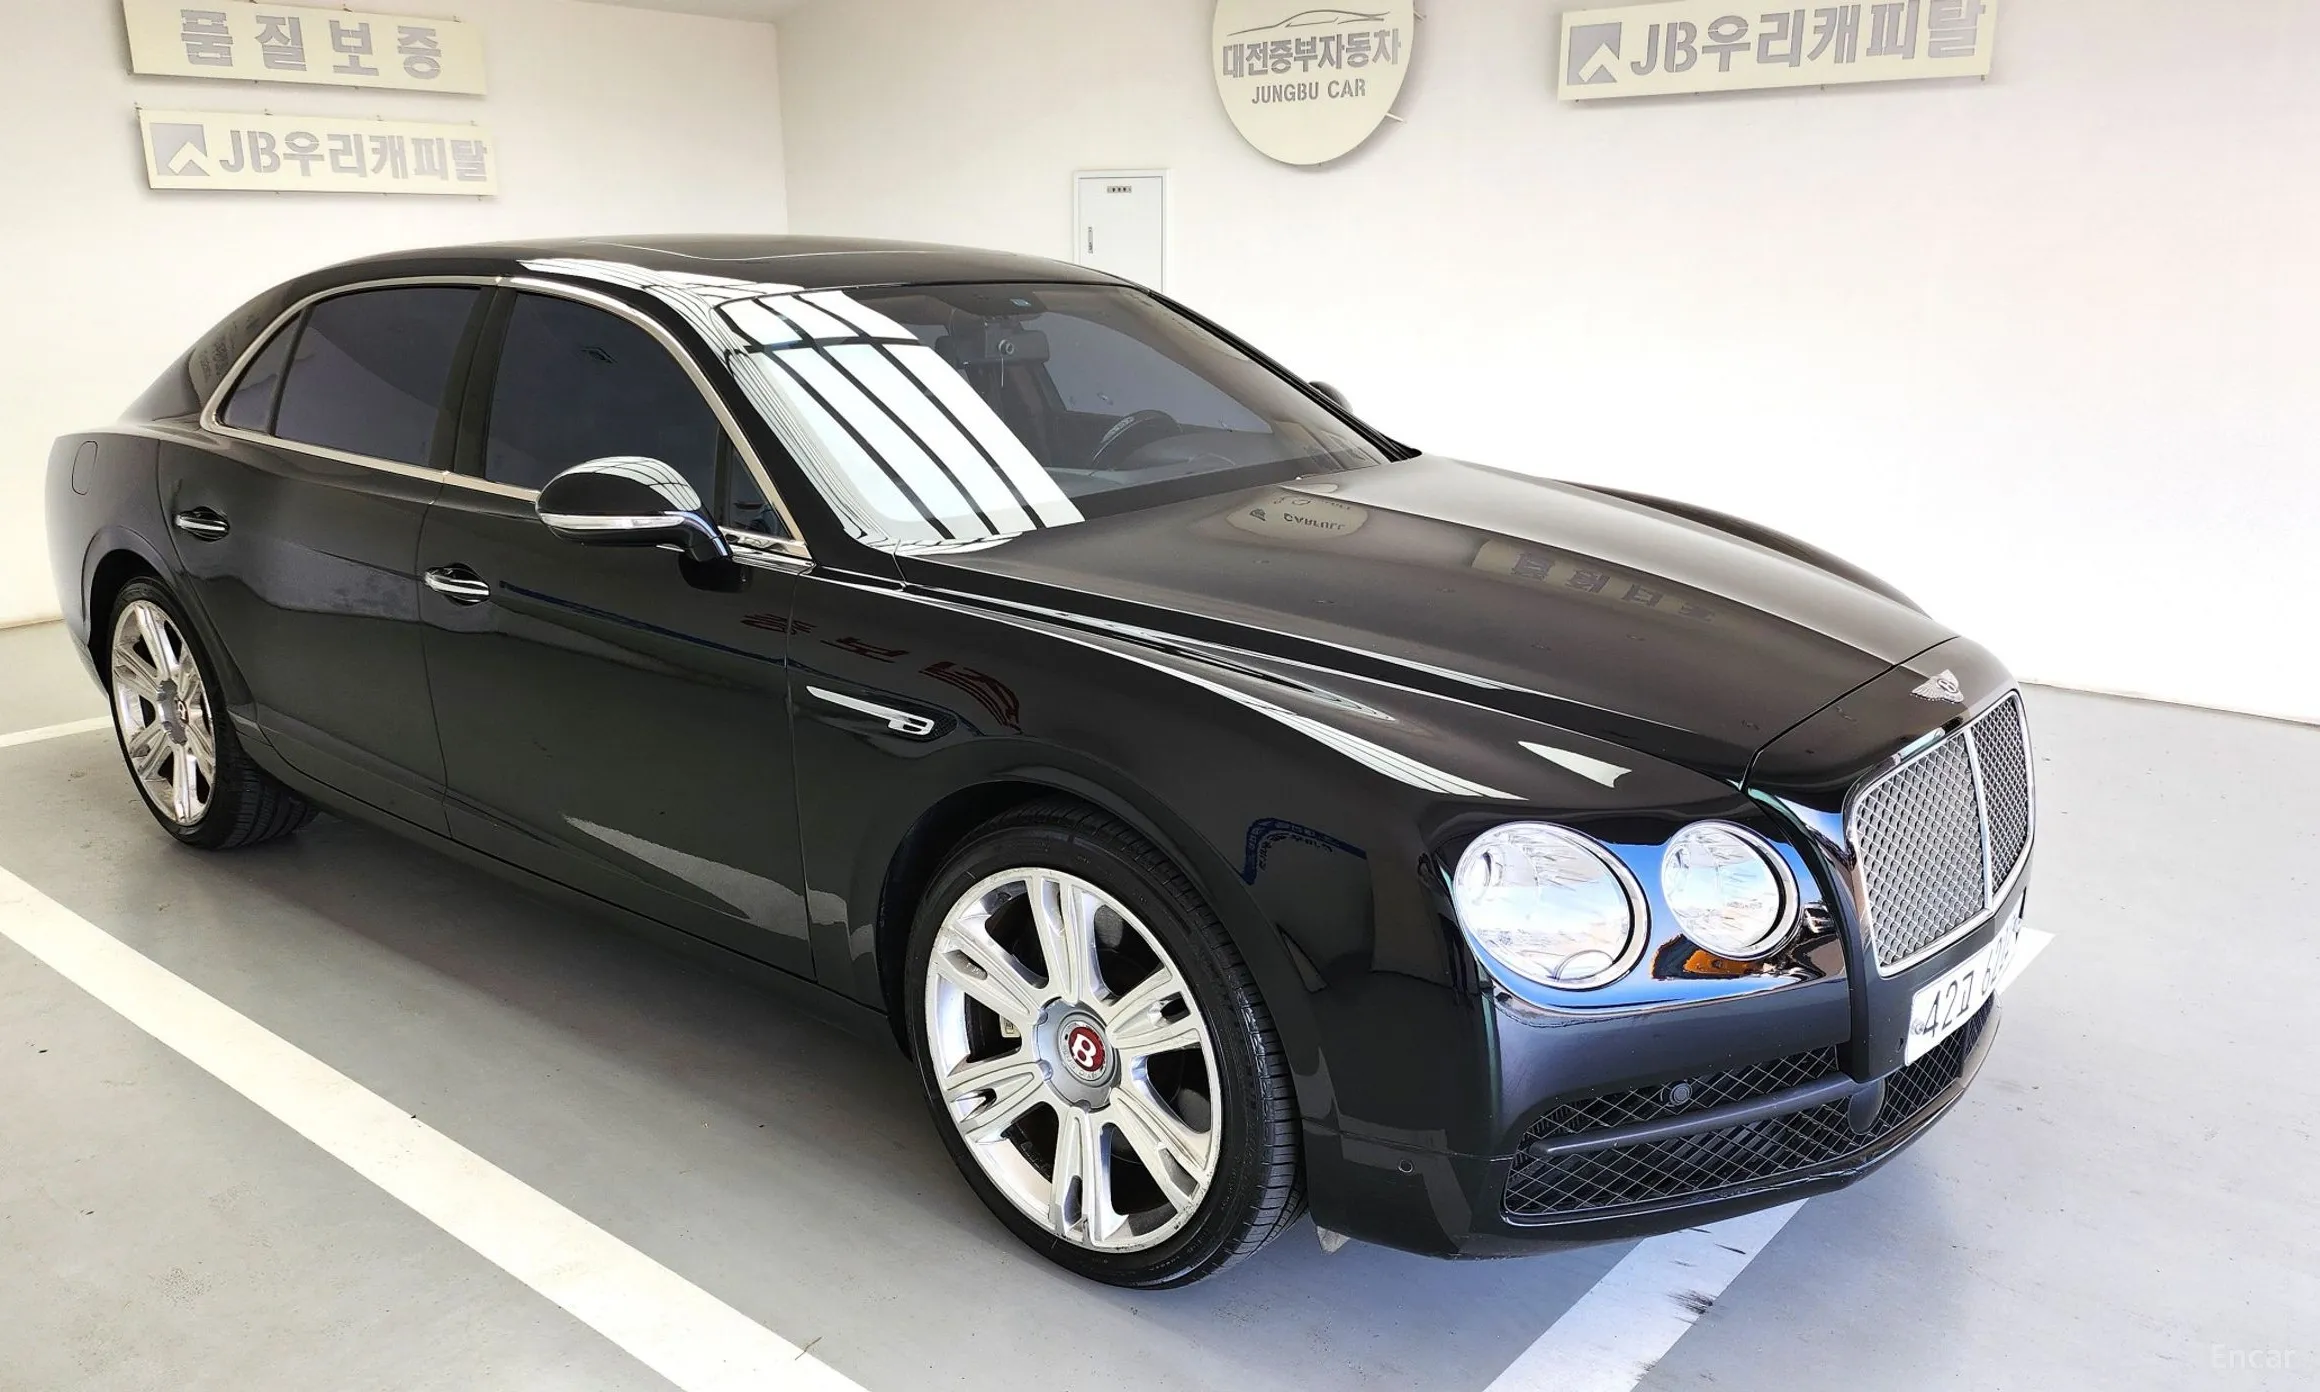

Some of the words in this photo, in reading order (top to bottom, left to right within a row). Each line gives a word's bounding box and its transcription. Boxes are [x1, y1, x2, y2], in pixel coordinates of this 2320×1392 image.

[180, 9, 442, 80] 품질보증
[1222, 28, 1402, 79] 대전중부자동차
[1631, 0, 1987, 76] JB우리캐피탈
[1252, 81, 1319, 104] JUNGBU
[1327, 78, 1366, 99] CAR
[218, 129, 489, 182] JB우리캐피탈
[1071, 1033, 1097, 1068] B
